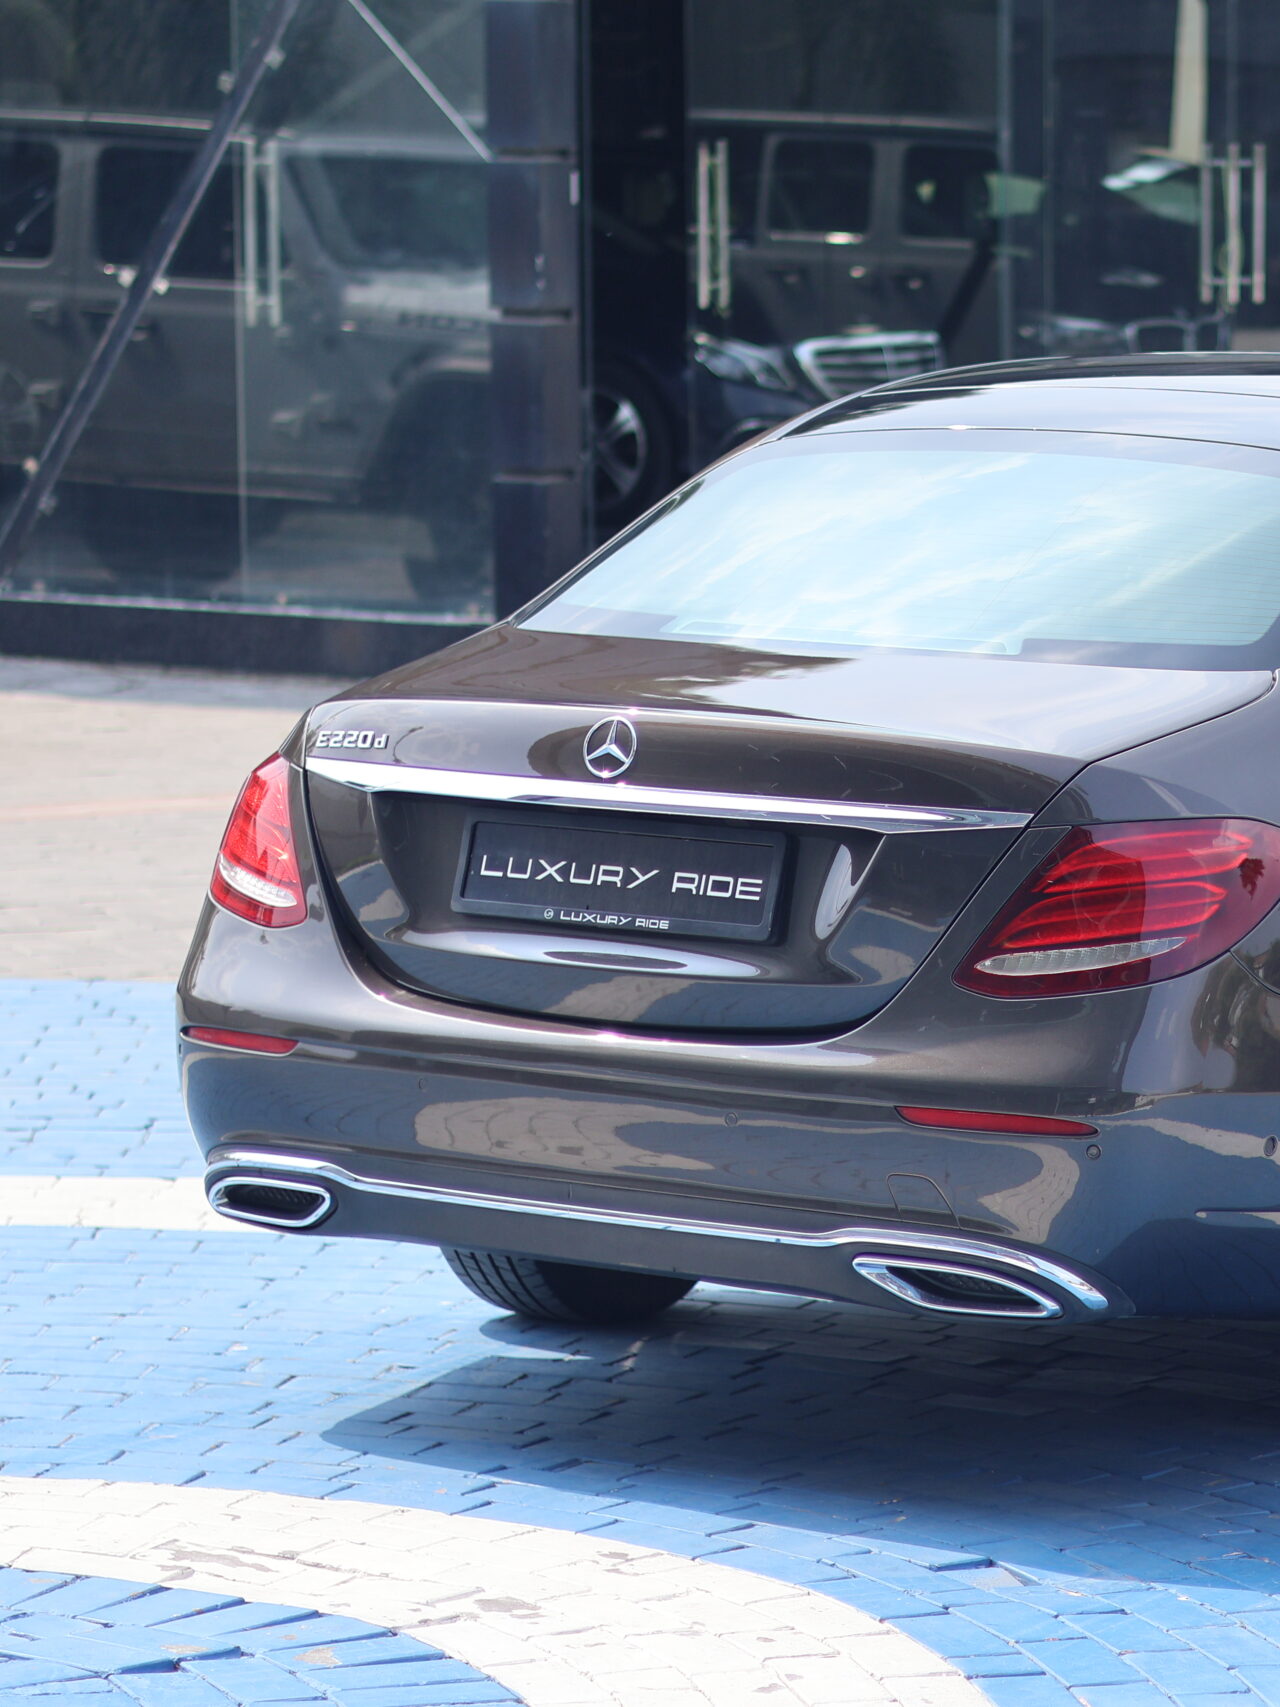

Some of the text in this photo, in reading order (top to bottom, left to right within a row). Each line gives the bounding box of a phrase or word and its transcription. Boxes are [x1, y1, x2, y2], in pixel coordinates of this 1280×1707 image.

[480, 855, 763, 901] LUXURY RIDE
[560, 910, 670, 930] LUXURY RIDE
